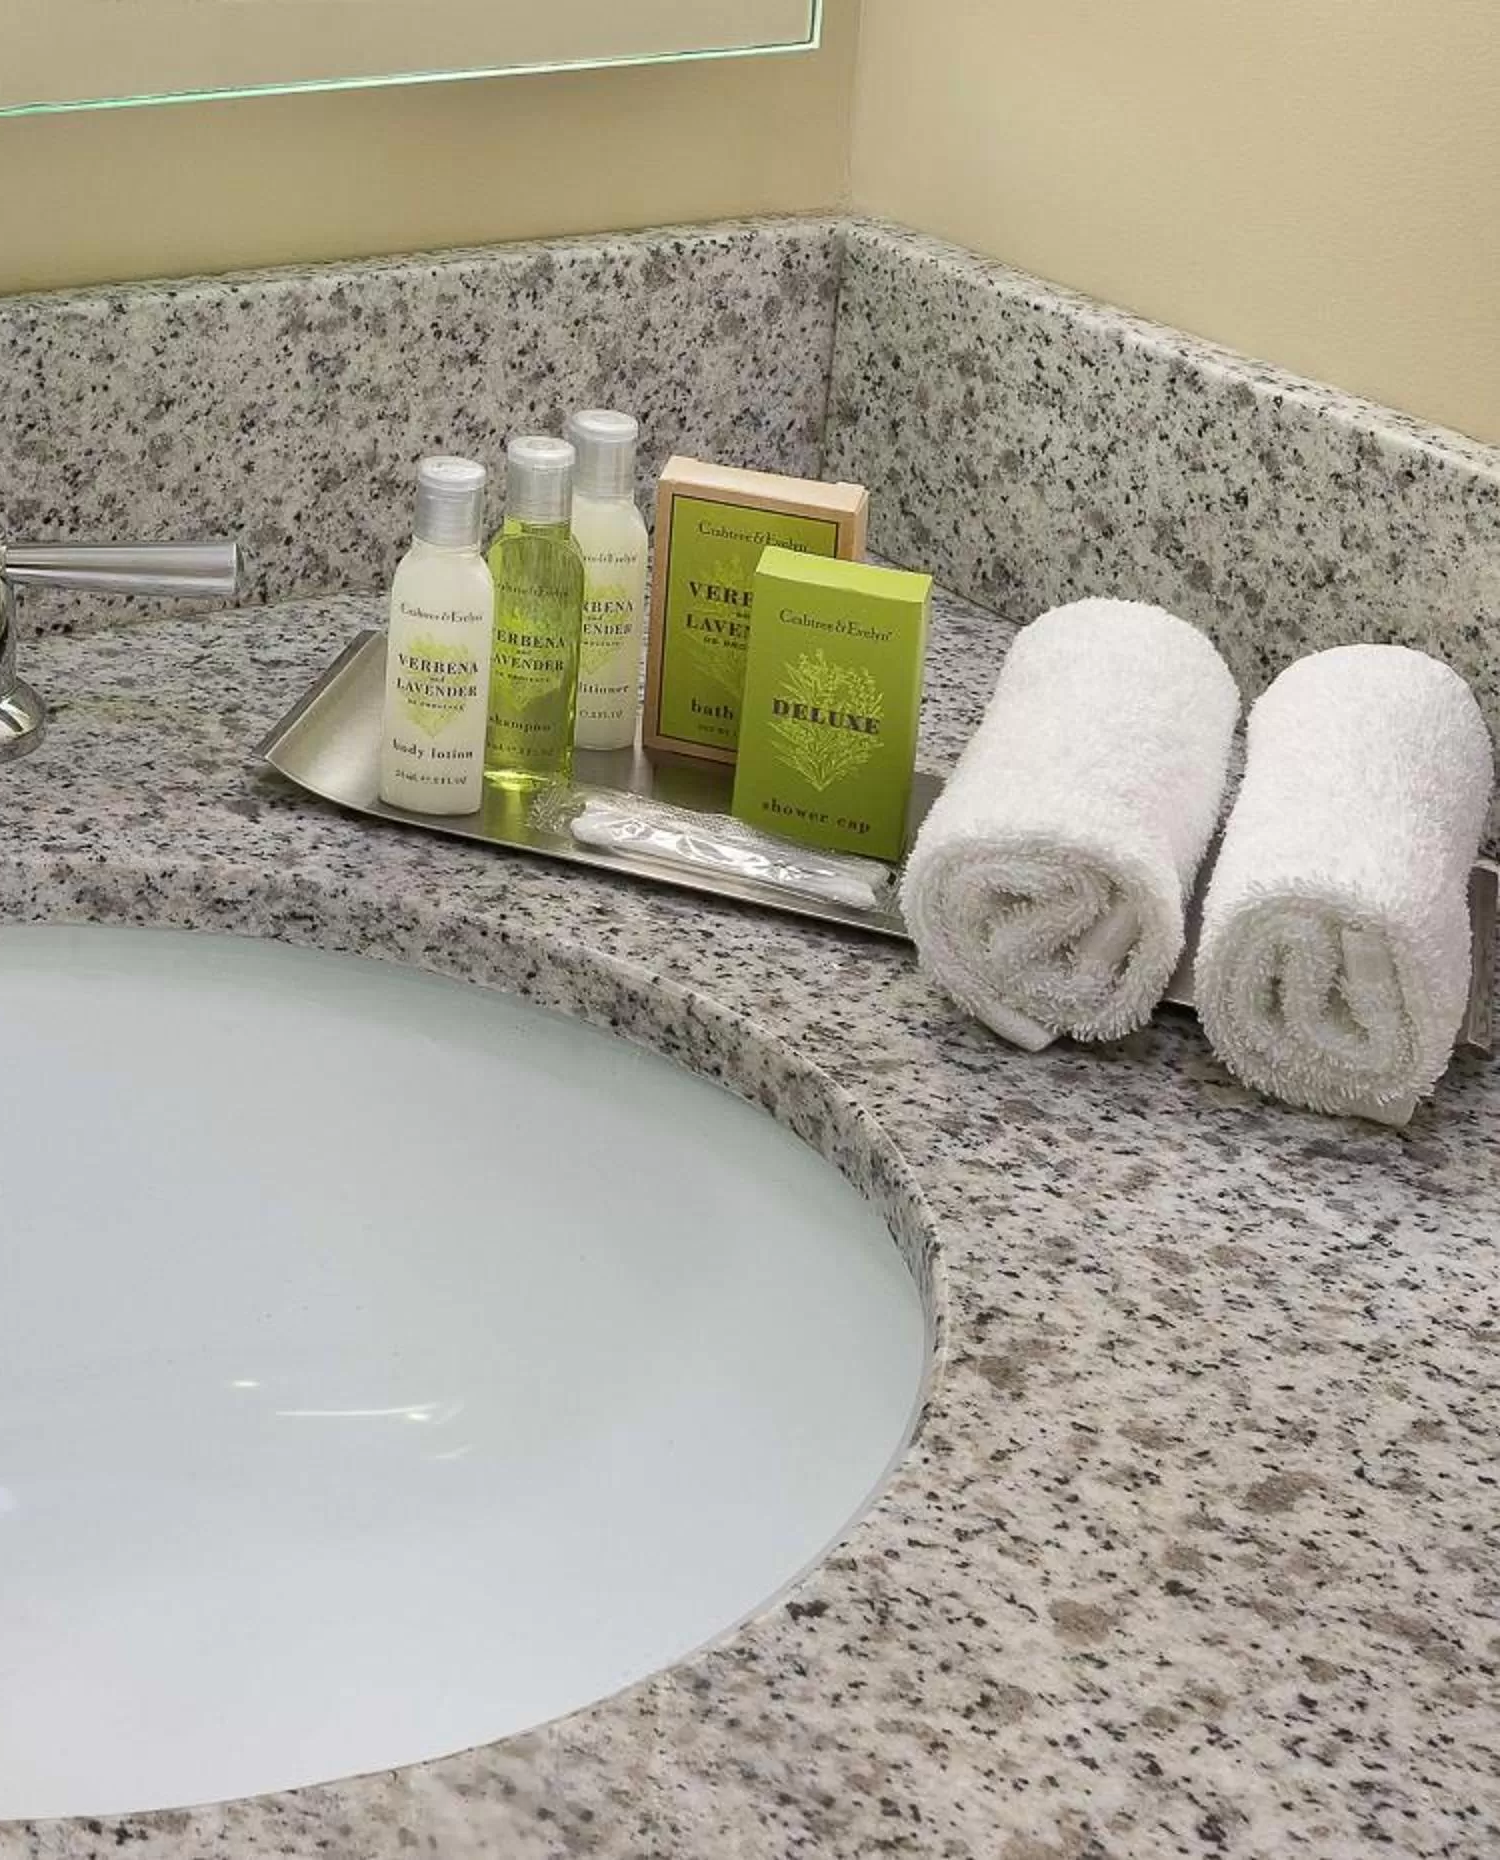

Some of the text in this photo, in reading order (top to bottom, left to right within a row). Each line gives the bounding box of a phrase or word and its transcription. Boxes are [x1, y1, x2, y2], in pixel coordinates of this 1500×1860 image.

[690, 581, 754, 607] VERB
[583, 601, 634, 613] RBENA
[583, 623, 633, 635] ENDER
[779, 607, 834, 632] Crabtree
[492, 628, 565, 649] ERBENA
[398, 653, 479, 675] VERBENA
[491, 653, 565, 671] AVENDER
[397, 677, 477, 697] LAVENDER
[691, 697, 734, 721] bath
[772, 697, 882, 735] DELUXE
[392, 738, 425, 760] body
[431, 747, 474, 760] lotion
[762, 797, 872, 835] shower cap
